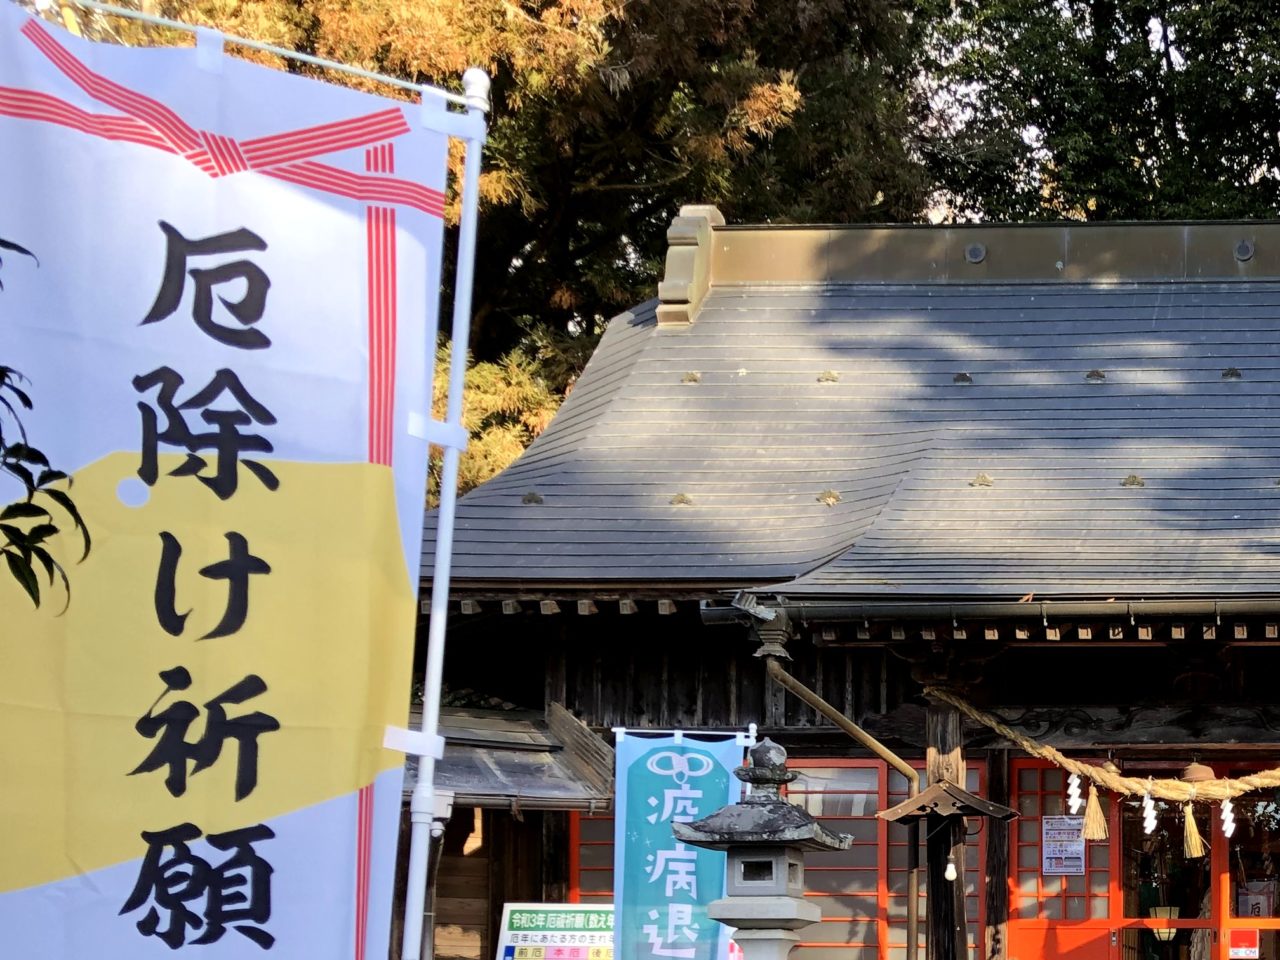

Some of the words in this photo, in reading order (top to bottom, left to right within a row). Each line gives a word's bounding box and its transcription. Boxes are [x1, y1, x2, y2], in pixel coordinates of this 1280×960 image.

[118, 218, 281, 951] 厄除け祈願
